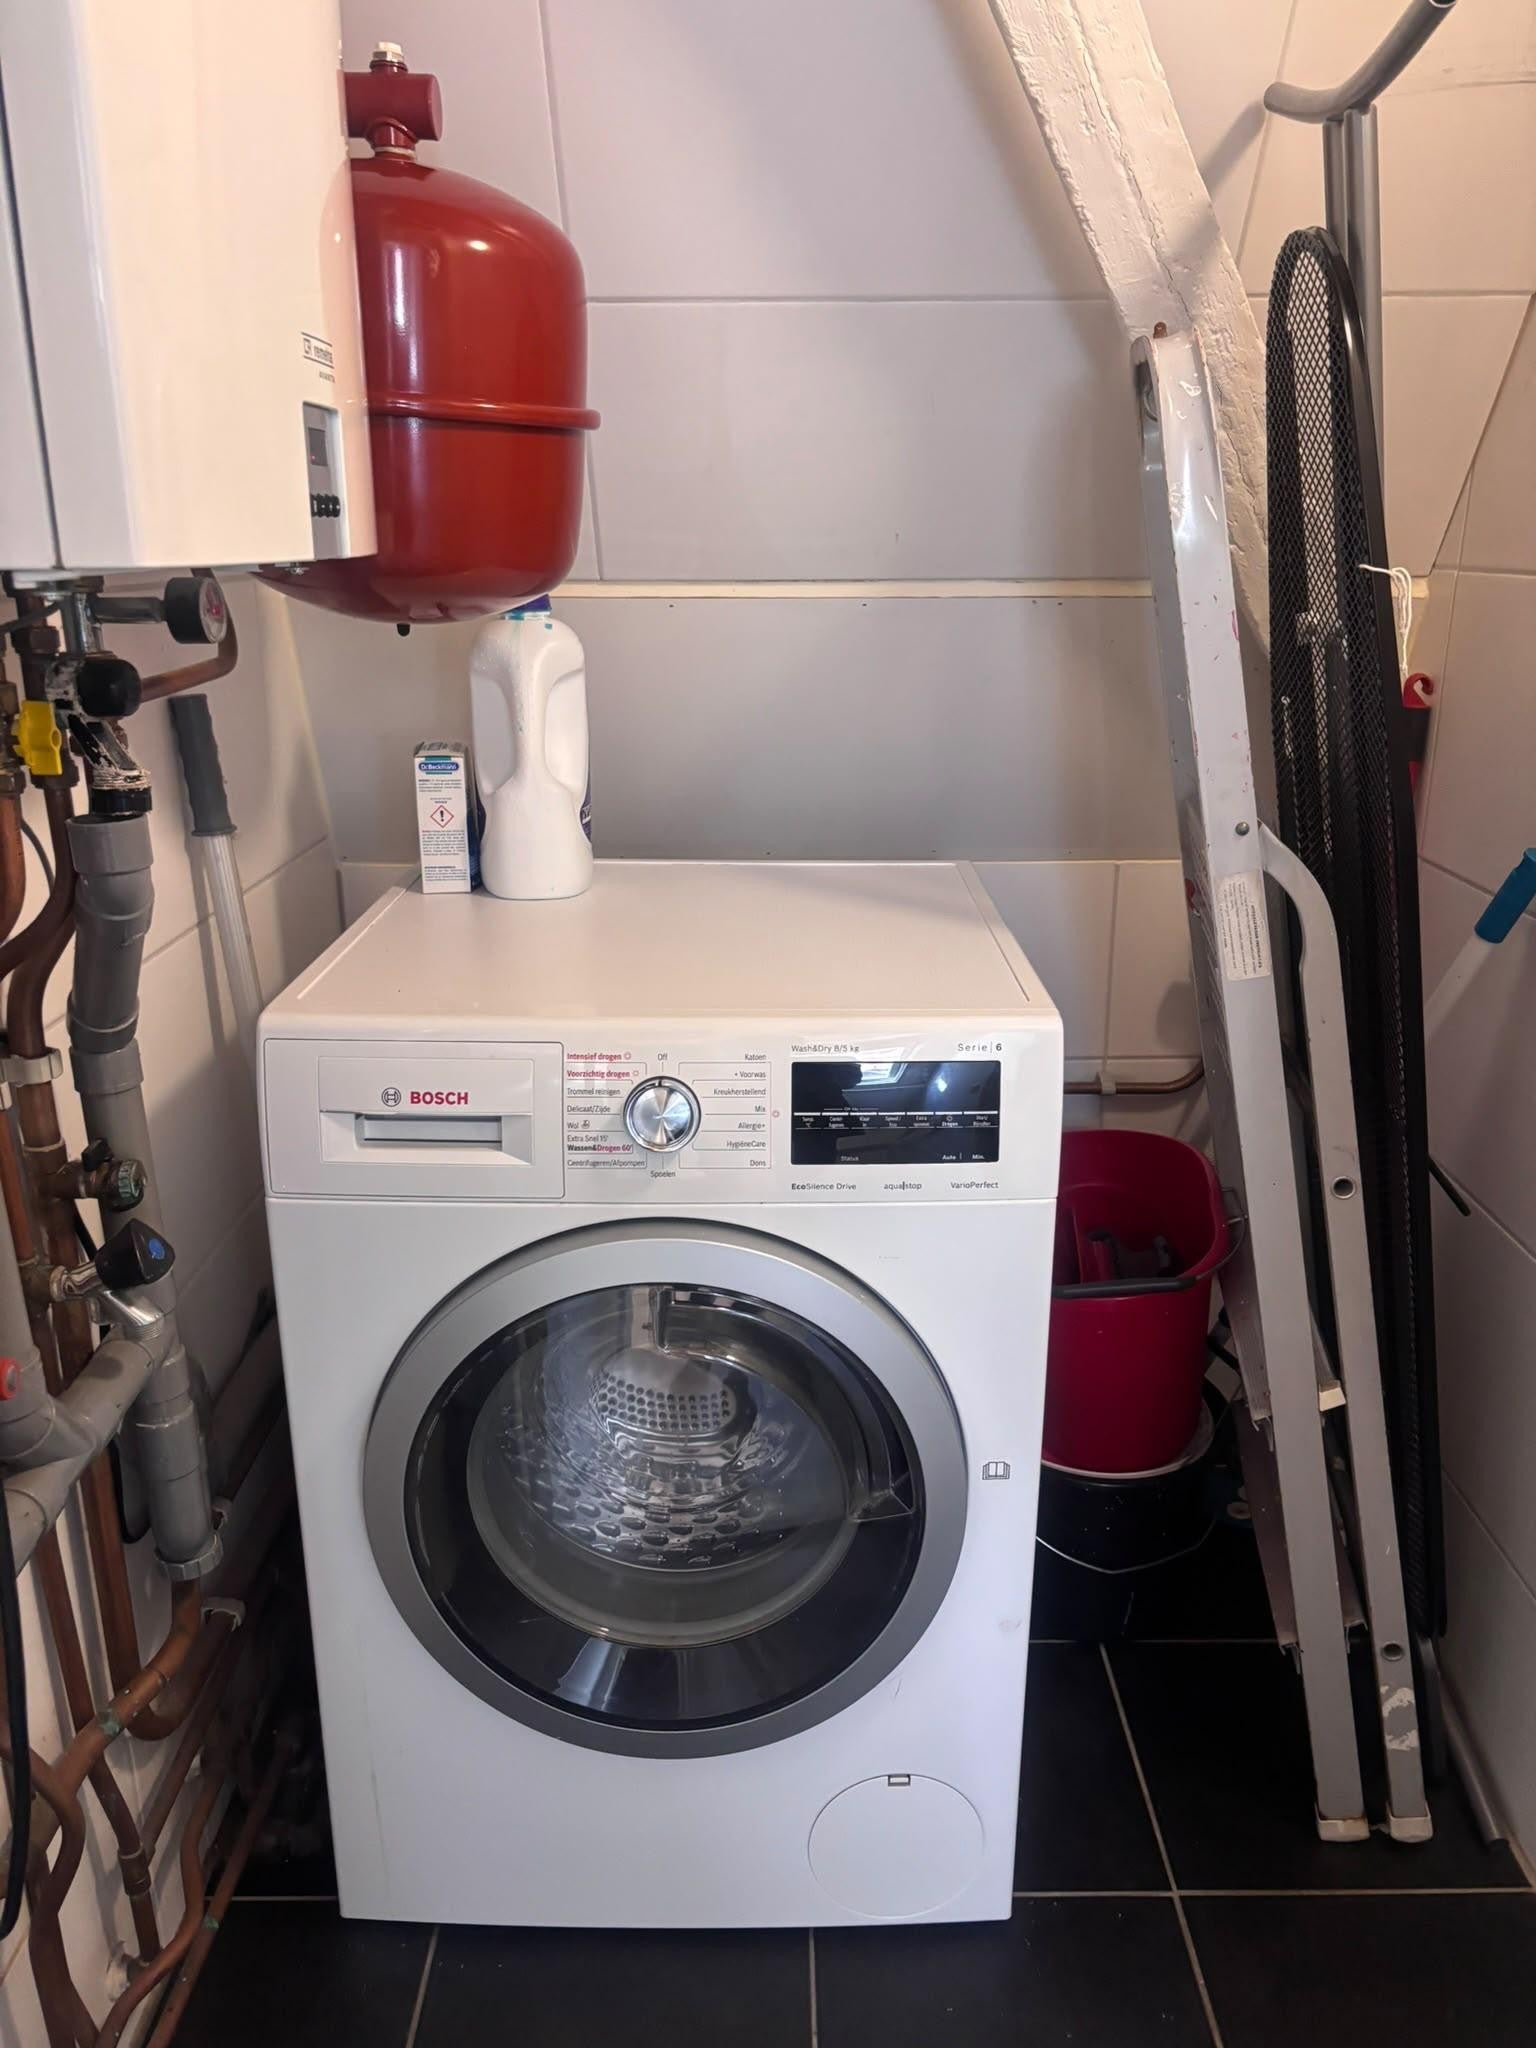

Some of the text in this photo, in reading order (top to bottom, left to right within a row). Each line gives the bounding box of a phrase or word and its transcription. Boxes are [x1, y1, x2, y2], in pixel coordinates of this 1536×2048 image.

[791, 1044, 860, 1053] Wash&Dry 8/5 kg
[958, 1043, 1002, 1051] Serie 6
[567, 1052, 622, 1062] Intensief drogen
[657, 1053, 668, 1061] Off
[744, 1053, 766, 1061] Katoen
[567, 1070, 630, 1079] Voorzichtig drogen
[410, 1091, 469, 1105] BOSCH
[650, 1170, 676, 1179] Spoelen
